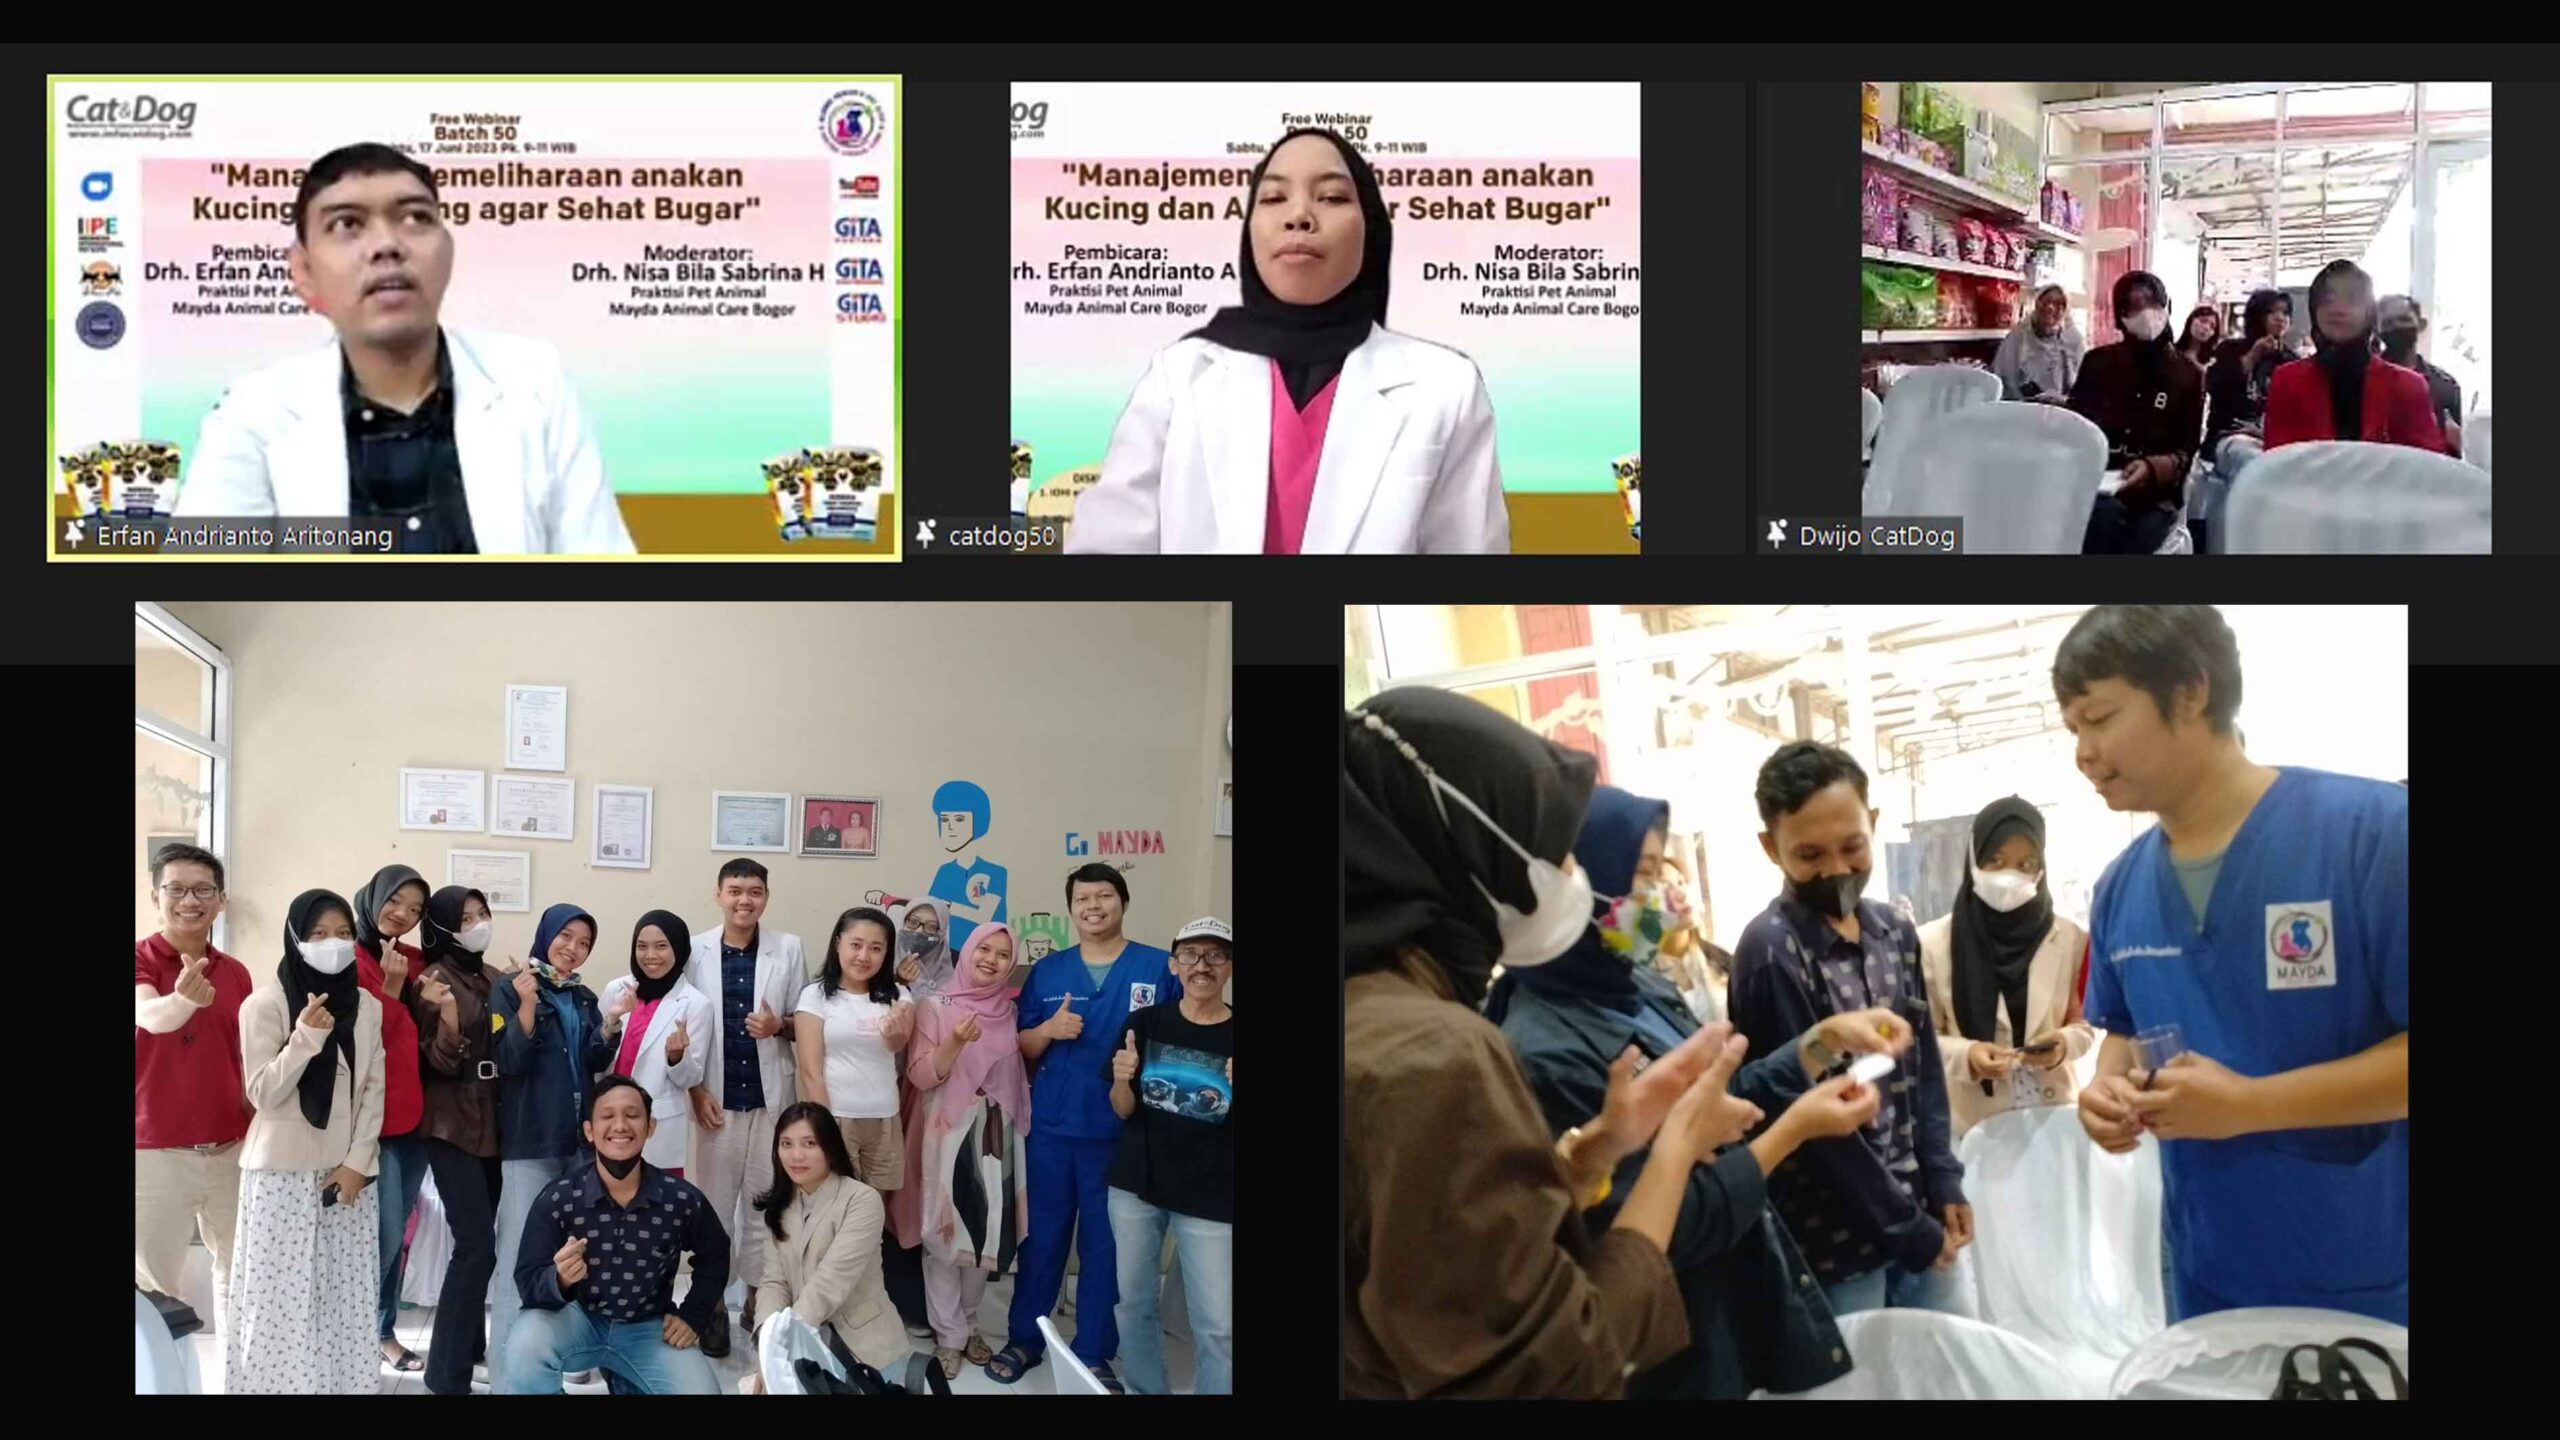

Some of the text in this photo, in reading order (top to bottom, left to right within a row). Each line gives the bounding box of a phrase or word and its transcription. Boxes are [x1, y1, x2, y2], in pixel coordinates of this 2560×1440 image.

[66, 94, 197, 129] Cat&Dog
[430, 113, 521, 125] Free Webinar
[1282, 113, 1373, 125] Free Webinar
[434, 126, 518, 140] Batch 50
[1344, 126, 1368, 140] 50
[467, 143, 497, 154] 2023
[550, 143, 577, 154] WIB
[1401, 142, 1427, 153] WIB
[211, 162, 744, 187] "Mana emeliharaan anakan
[1482, 162, 1594, 187] anakan
[193, 196, 298, 225] Kucing
[480, 201, 549, 226] agar
[557, 196, 646, 221] Sehat
[654, 197, 760, 226] Bugar"
[1045, 196, 1149, 225] Kucing
[1158, 196, 1214, 220] dan
[1409, 196, 1496, 220] Sehat
[1505, 196, 1611, 225] Bugar"
[212, 244, 291, 261] Pembica
[644, 245, 753, 261] Moderator:
[1064, 244, 1168, 260] Pembicara:
[1494, 244, 1603, 260] Moderator:
[144, 262, 189, 281] Drh.
[196, 262, 251, 281] Erfan
[572, 263, 825, 282] Drh. Nisa Bila Sabrina H
[1013, 261, 1041, 280] rh.
[1048, 261, 1102, 280] Erfan
[1108, 261, 1215, 280] Andrianto
[1423, 262, 1640, 281] Drh. Nisa Bila Sabrin
[198, 285, 250, 298] Praktisi
[253, 285, 277, 298] Pet
[631, 286, 767, 298] Praktisi Pet Animal
[1050, 284, 1182, 298] Praktisi Pet Animal
[1482, 285, 1616, 298] Praktisi Pet Animal
[172, 302, 221, 317] Mayda
[225, 302, 275, 316] Animal
[609, 303, 796, 318] Mayda Animal Care Bogor
[1024, 301, 1207, 317] Mayda Animal Care Bogor
[1461, 302, 1640, 318] Mayda Animal Care Bogo
[1097, 830, 1166, 855] MAYDA
[2276, 964, 2327, 979] MAYDA
